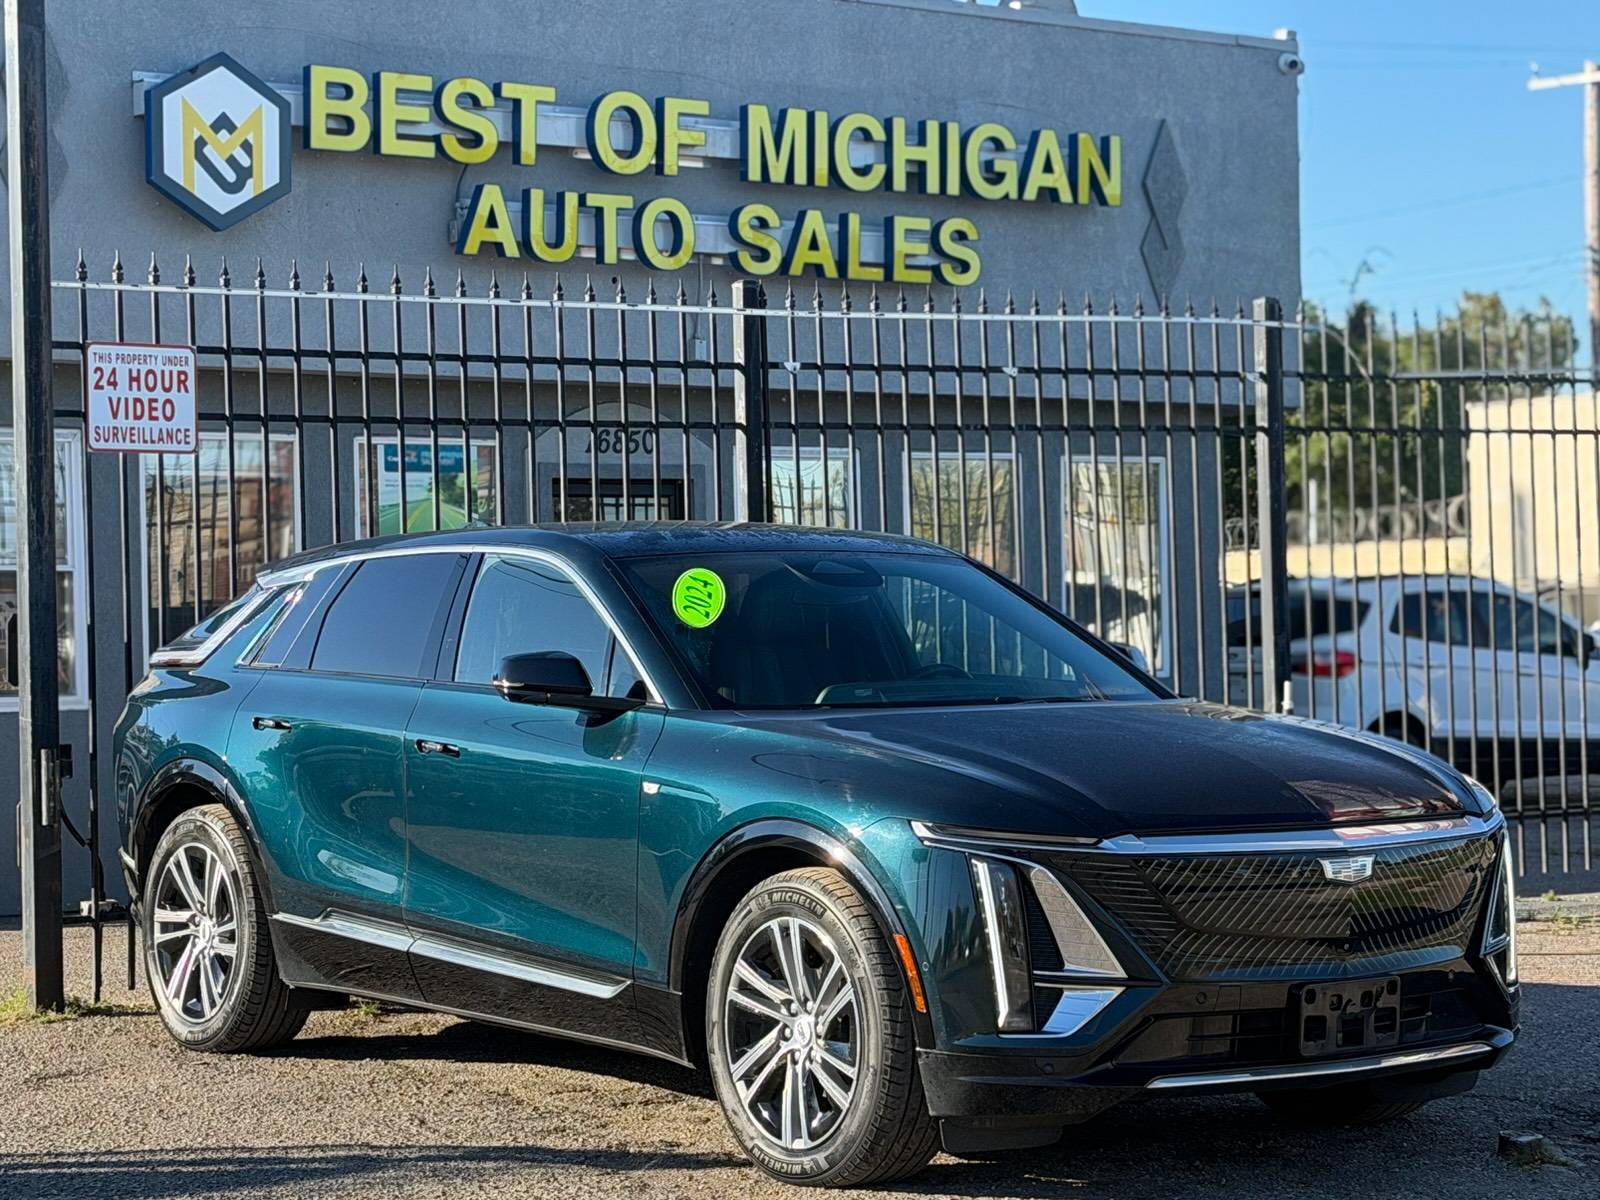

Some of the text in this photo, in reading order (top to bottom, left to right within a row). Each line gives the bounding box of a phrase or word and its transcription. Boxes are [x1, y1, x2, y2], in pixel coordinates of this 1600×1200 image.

[304, 64, 1122, 207] BEST OF MICHIGAN
[458, 183, 982, 287] AUTO SALES
[93, 352, 190, 367] THIS PROPERTY UNDER
[93, 366, 190, 394] 24 HOUR
[108, 396, 176, 422] VIDEO
[94, 425, 191, 446] SURVEILLANCE
[682, 574, 714, 620] 2024
[771, 891, 825, 917] MICHELIN
[752, 1146, 802, 1175] MICHELIN
